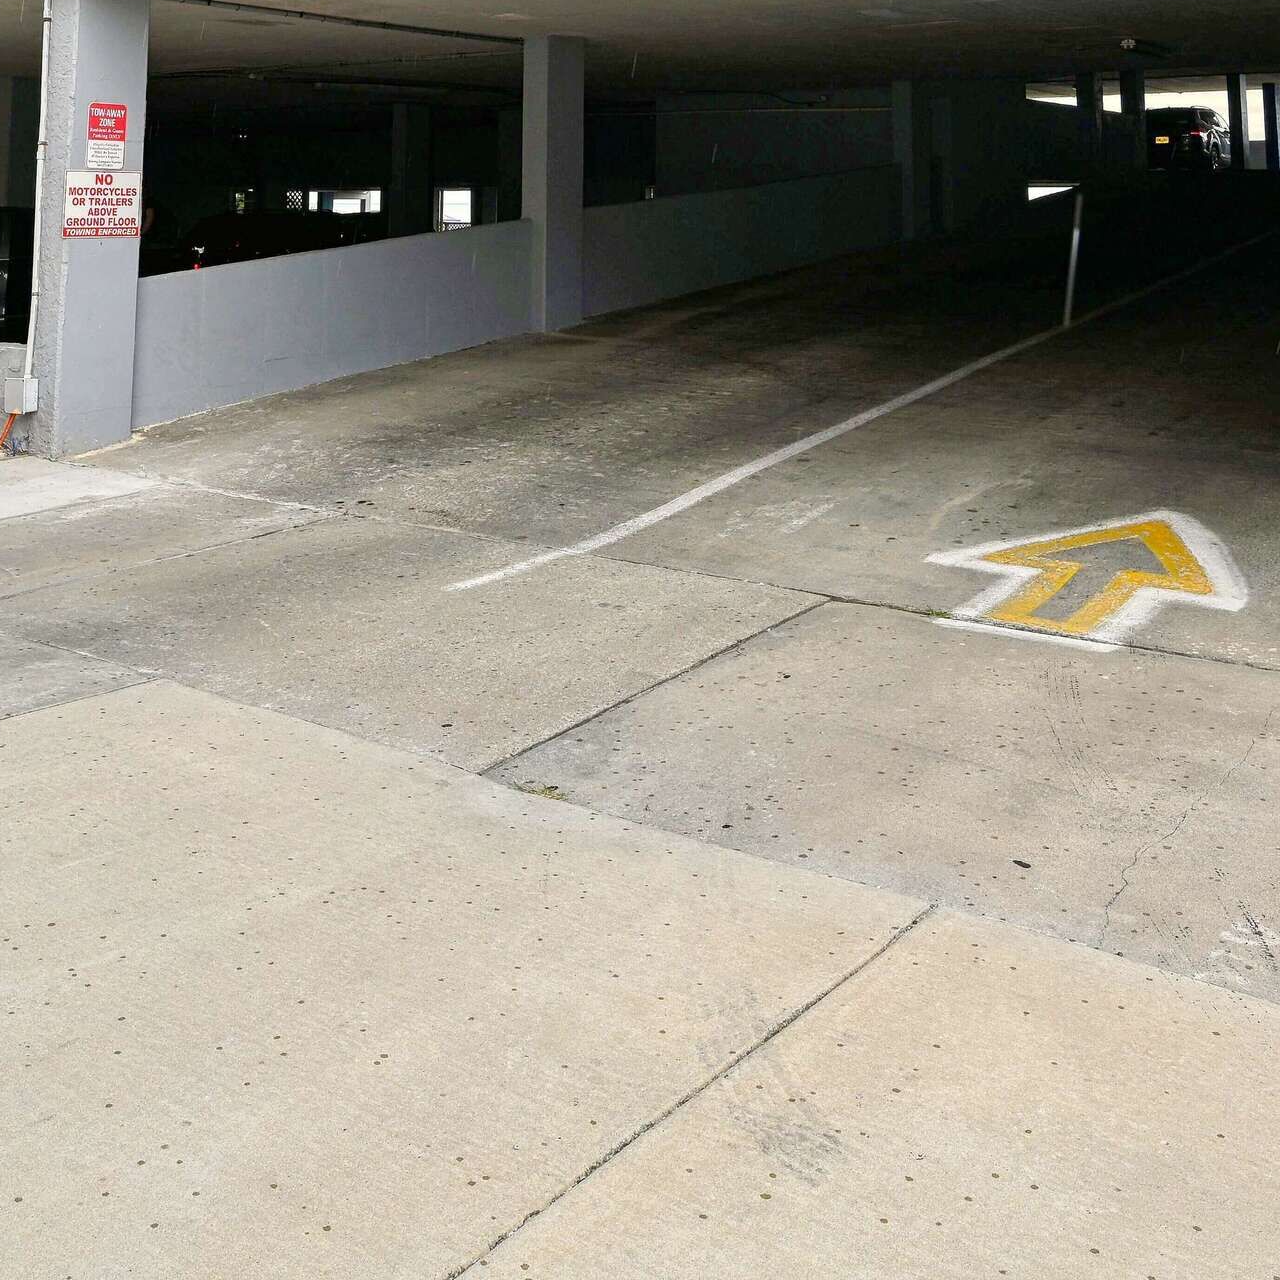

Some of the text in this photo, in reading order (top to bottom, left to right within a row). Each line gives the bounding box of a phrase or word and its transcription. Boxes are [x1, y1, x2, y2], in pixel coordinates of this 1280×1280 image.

[99, 118, 116, 127] ZONE
[95, 174, 113, 185] NO
[68, 187, 137, 196] MOTORCYCLES
[72, 198, 133, 206] OR TRAILERS
[88, 208, 118, 216] ABOVE
[66, 218, 136, 226] GROUND FLOOR
